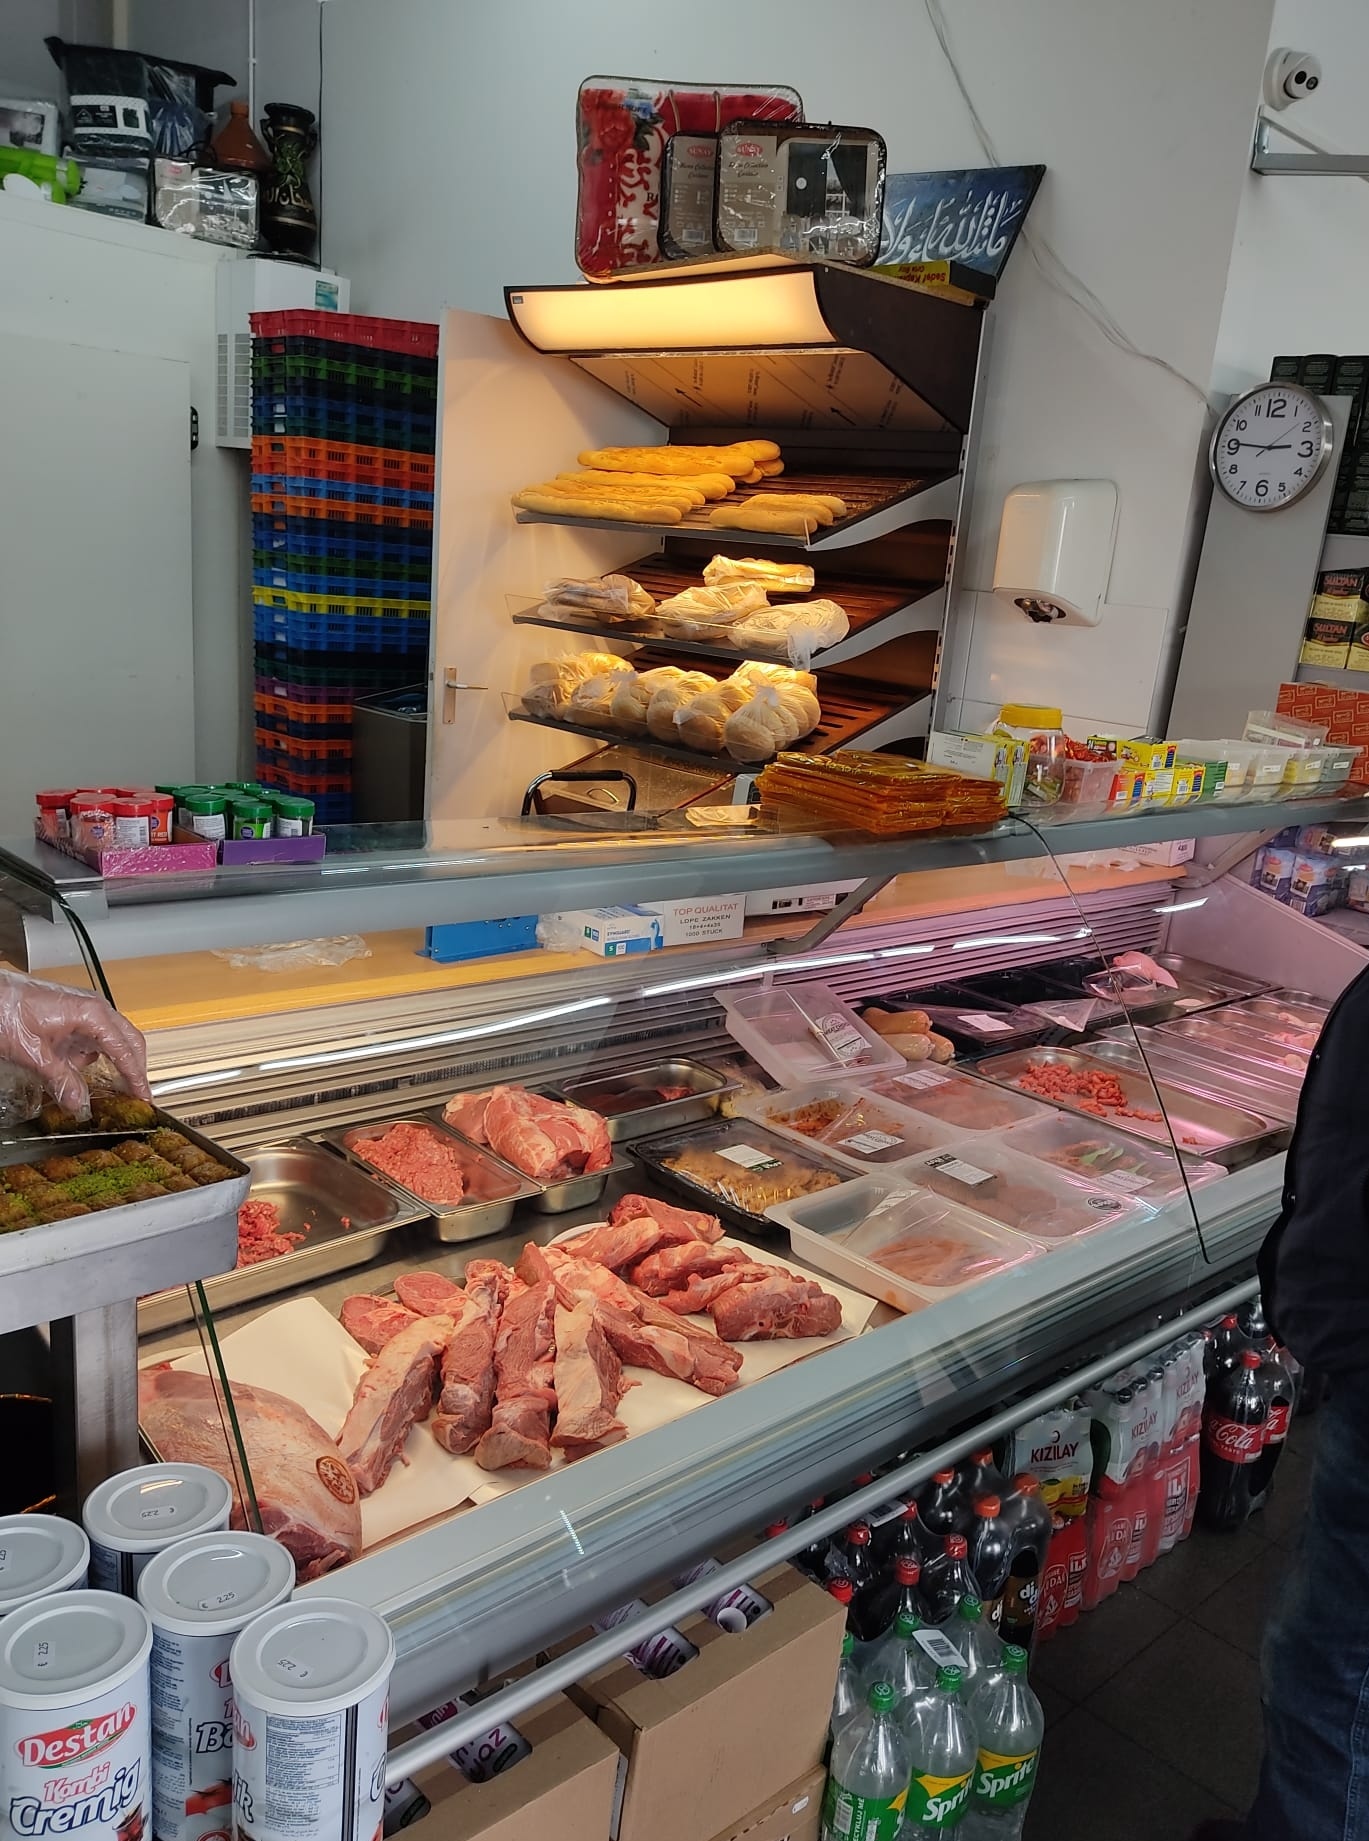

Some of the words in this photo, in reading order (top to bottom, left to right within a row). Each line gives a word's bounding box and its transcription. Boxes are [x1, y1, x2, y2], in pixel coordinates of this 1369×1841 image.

[1254, 404, 1262, 417] 11
[1265, 399, 1287, 418] 12
[1294, 405, 1298, 417] 1
[1236, 419, 1248, 431] 10
[1302, 421, 1312, 433] 2
[1227, 438, 1240, 456] 9
[1297, 440, 1314, 458] 3
[1228, 464, 1238, 474] 8
[1293, 467, 1303, 476] 4
[1238, 480, 1247, 491] 7
[1255, 479, 1269, 497] 6
[1278, 482, 1286, 492] 5
[1323, 575, 1358, 587] SULTAN
[1313, 623, 1348, 634] SULTAN
[673, 908, 694, 917] TOP
[1131, 1410, 1158, 1440] KIZILAY
[1030, 1441, 1079, 1463] KIZILAY
[23, 1701, 132, 1767] Destan
[10, 1756, 141, 1837] Cremig
